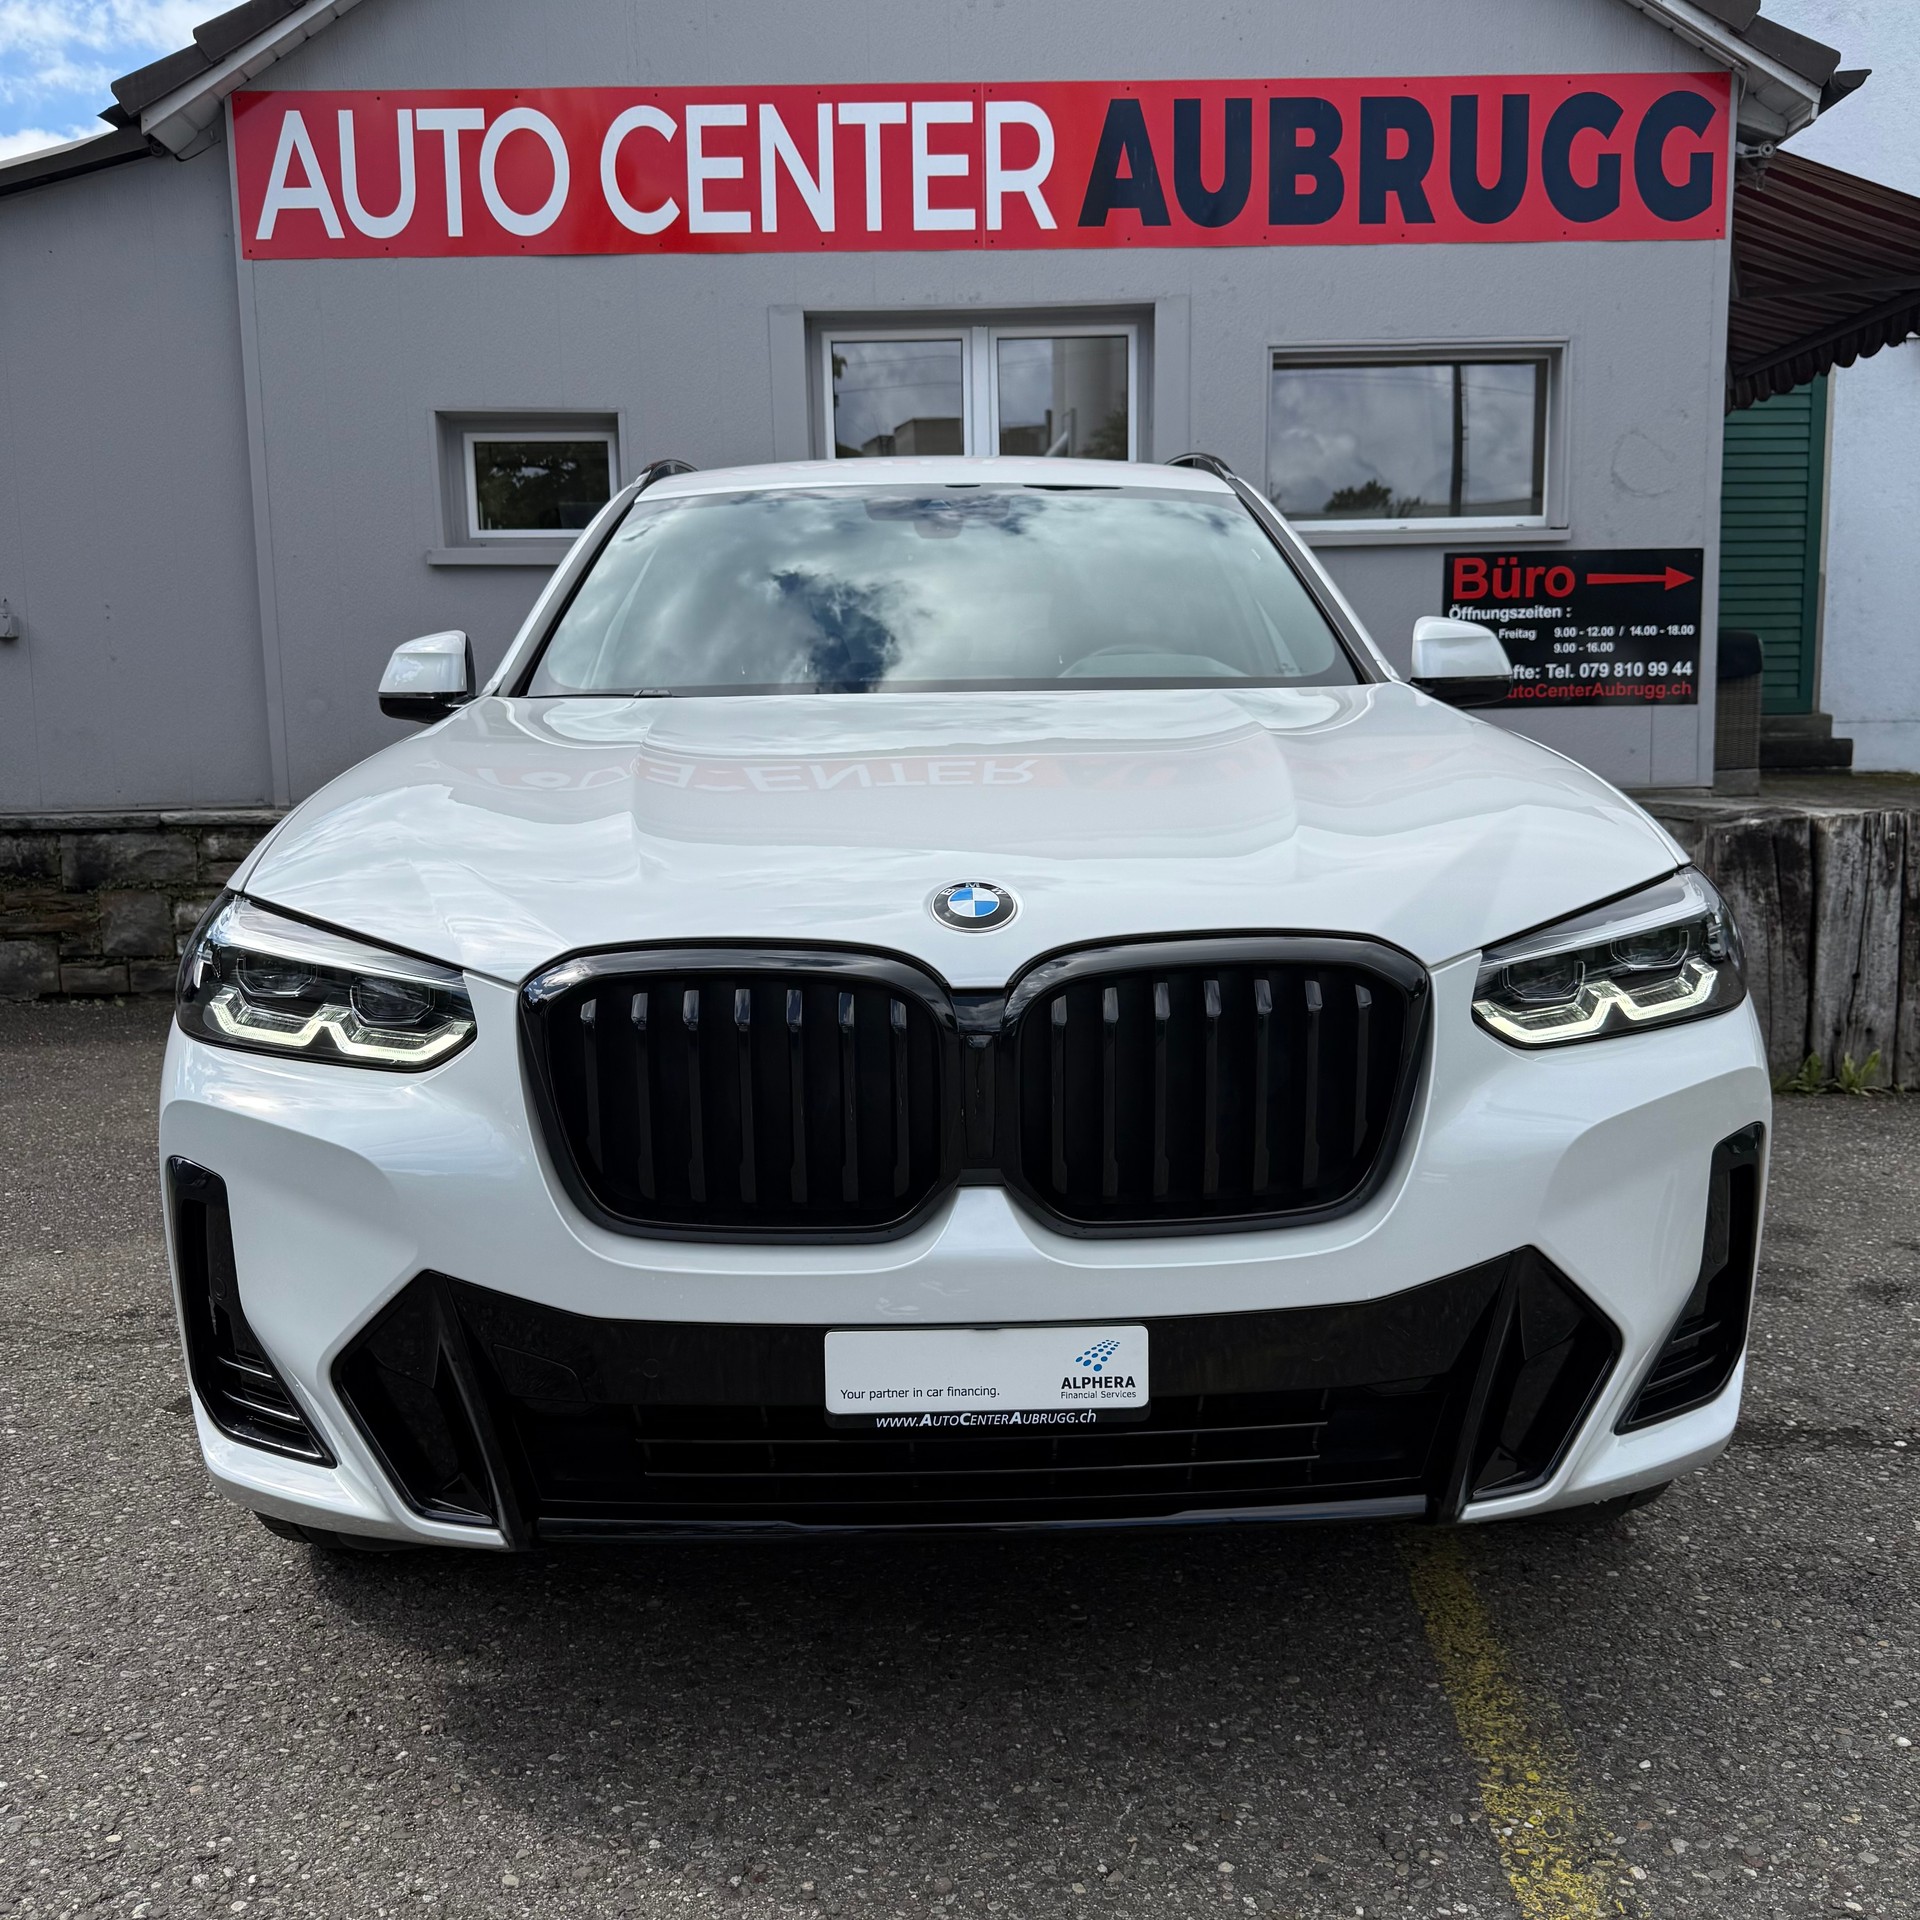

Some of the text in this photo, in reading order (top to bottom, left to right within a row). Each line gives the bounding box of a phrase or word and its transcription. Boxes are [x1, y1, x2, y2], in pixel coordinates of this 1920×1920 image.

[255, 90, 1717, 240] AUTO CENTER AUBRUGG
[1453, 556, 1576, 600] Büro
[1448, 604, 1563, 622] Öffnungszeiten
[1499, 628, 1538, 641] Freitag
[1553, 627, 1578, 638] 9.00
[1586, 626, 1615, 637] 12.00
[1629, 625, 1658, 636] 14.00
[1667, 624, 1695, 636] 18.00
[1553, 642, 1577, 653] 9.00
[1586, 641, 1615, 653] 16.00
[1512, 660, 1694, 680] fte: Tel. 079 810 99 44
[1506, 681, 1692, 699] utoCenterAubrugg.ch
[1061, 1376, 1136, 1390] ALPHERA
[841, 1385, 1000, 1401] Your partner in car financing.
[1060, 1389, 1137, 1399] Financial Services
